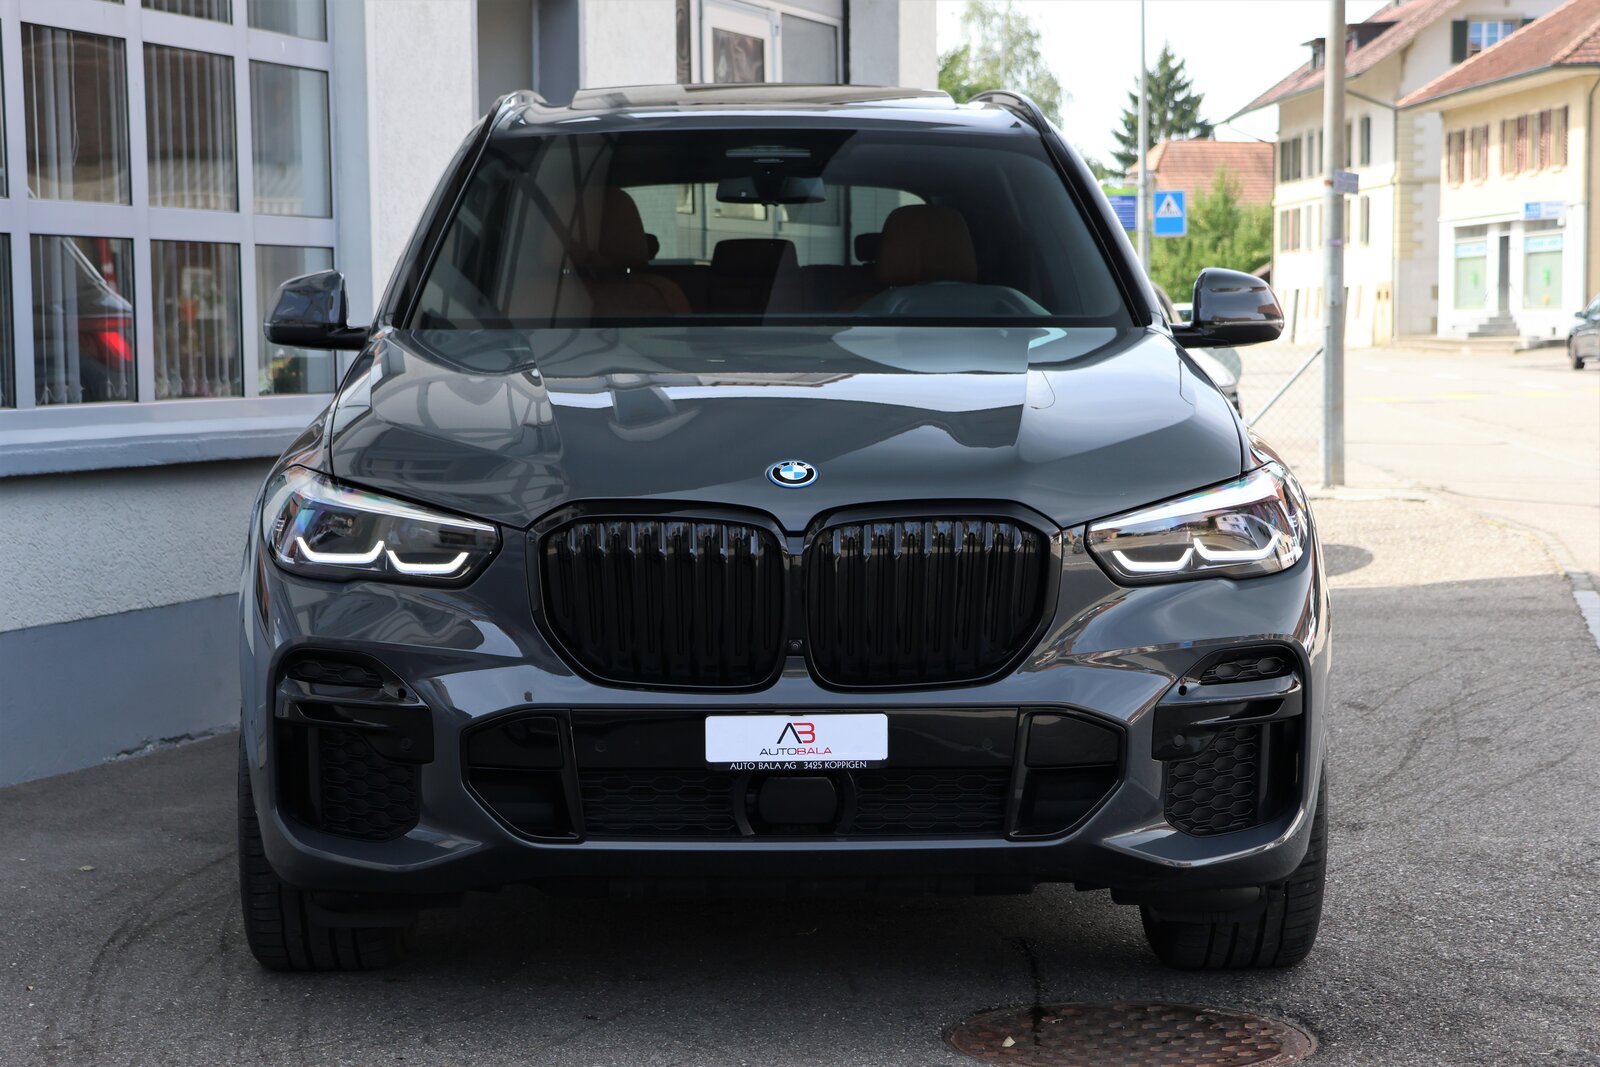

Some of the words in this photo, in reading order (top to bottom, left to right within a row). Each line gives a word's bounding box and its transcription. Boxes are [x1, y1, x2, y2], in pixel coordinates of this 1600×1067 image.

[759, 747, 832, 756] AUTOBALA
[729, 762, 756, 770] AUTO
[758, 761, 782, 770] BALA
[783, 761, 797, 769] AG
[803, 761, 823, 769] 3425
[824, 760, 867, 769] KOPPIGEN
